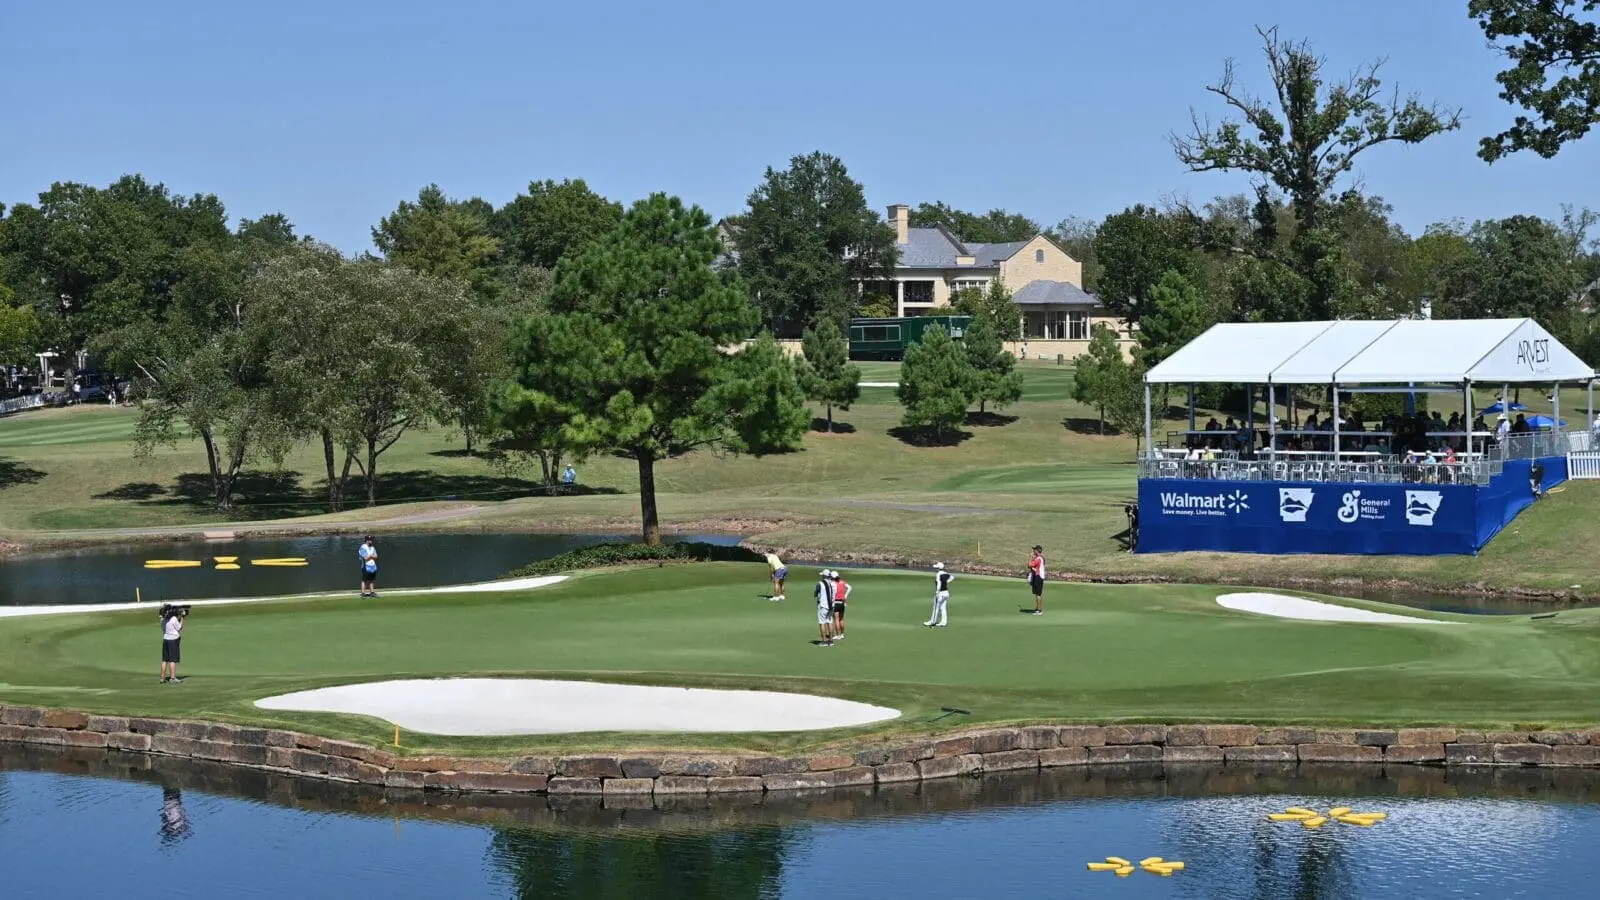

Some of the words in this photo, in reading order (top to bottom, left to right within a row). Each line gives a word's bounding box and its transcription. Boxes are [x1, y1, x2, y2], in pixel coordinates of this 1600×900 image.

[1517, 339, 1549, 371] ARVEST
[1160, 492, 1225, 509] Walmart
[1360, 498, 1391, 506] General
[1360, 506, 1378, 514] Mills
